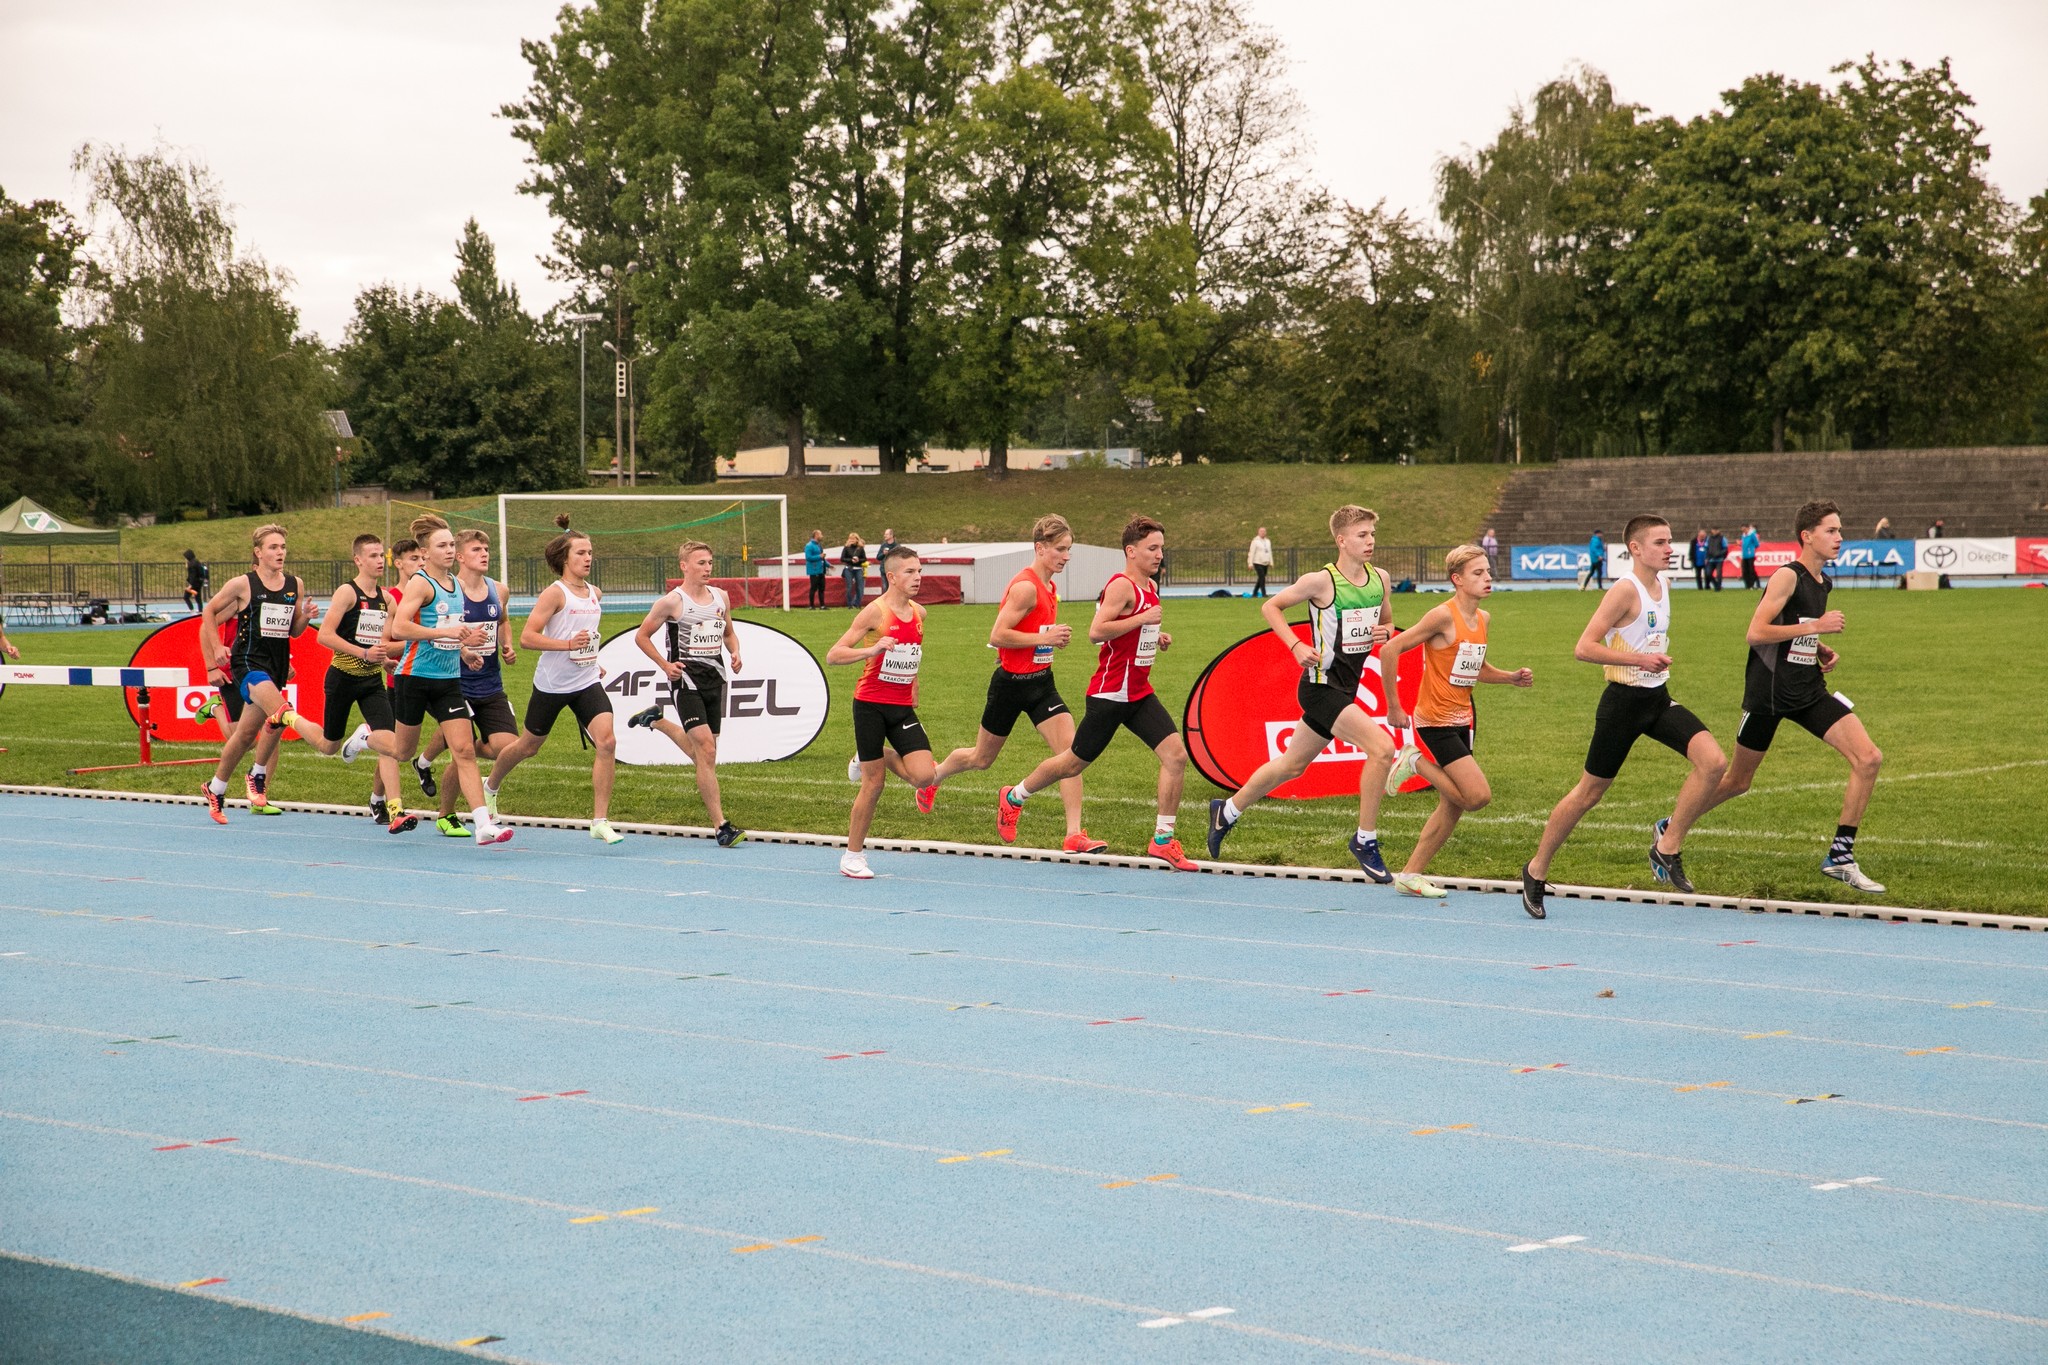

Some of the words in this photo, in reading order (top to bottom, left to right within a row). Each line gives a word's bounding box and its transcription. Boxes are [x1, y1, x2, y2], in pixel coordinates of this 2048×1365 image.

[1520, 553, 1591, 570] MZLA
[380, 612, 387, 620] 34
[1373, 608, 1379, 618] 6
[266, 617, 290, 626] BRYZA
[713, 621, 723, 629] 48
[1477, 646, 1486, 656] 17
[1032, 669, 1047, 679] PRO
